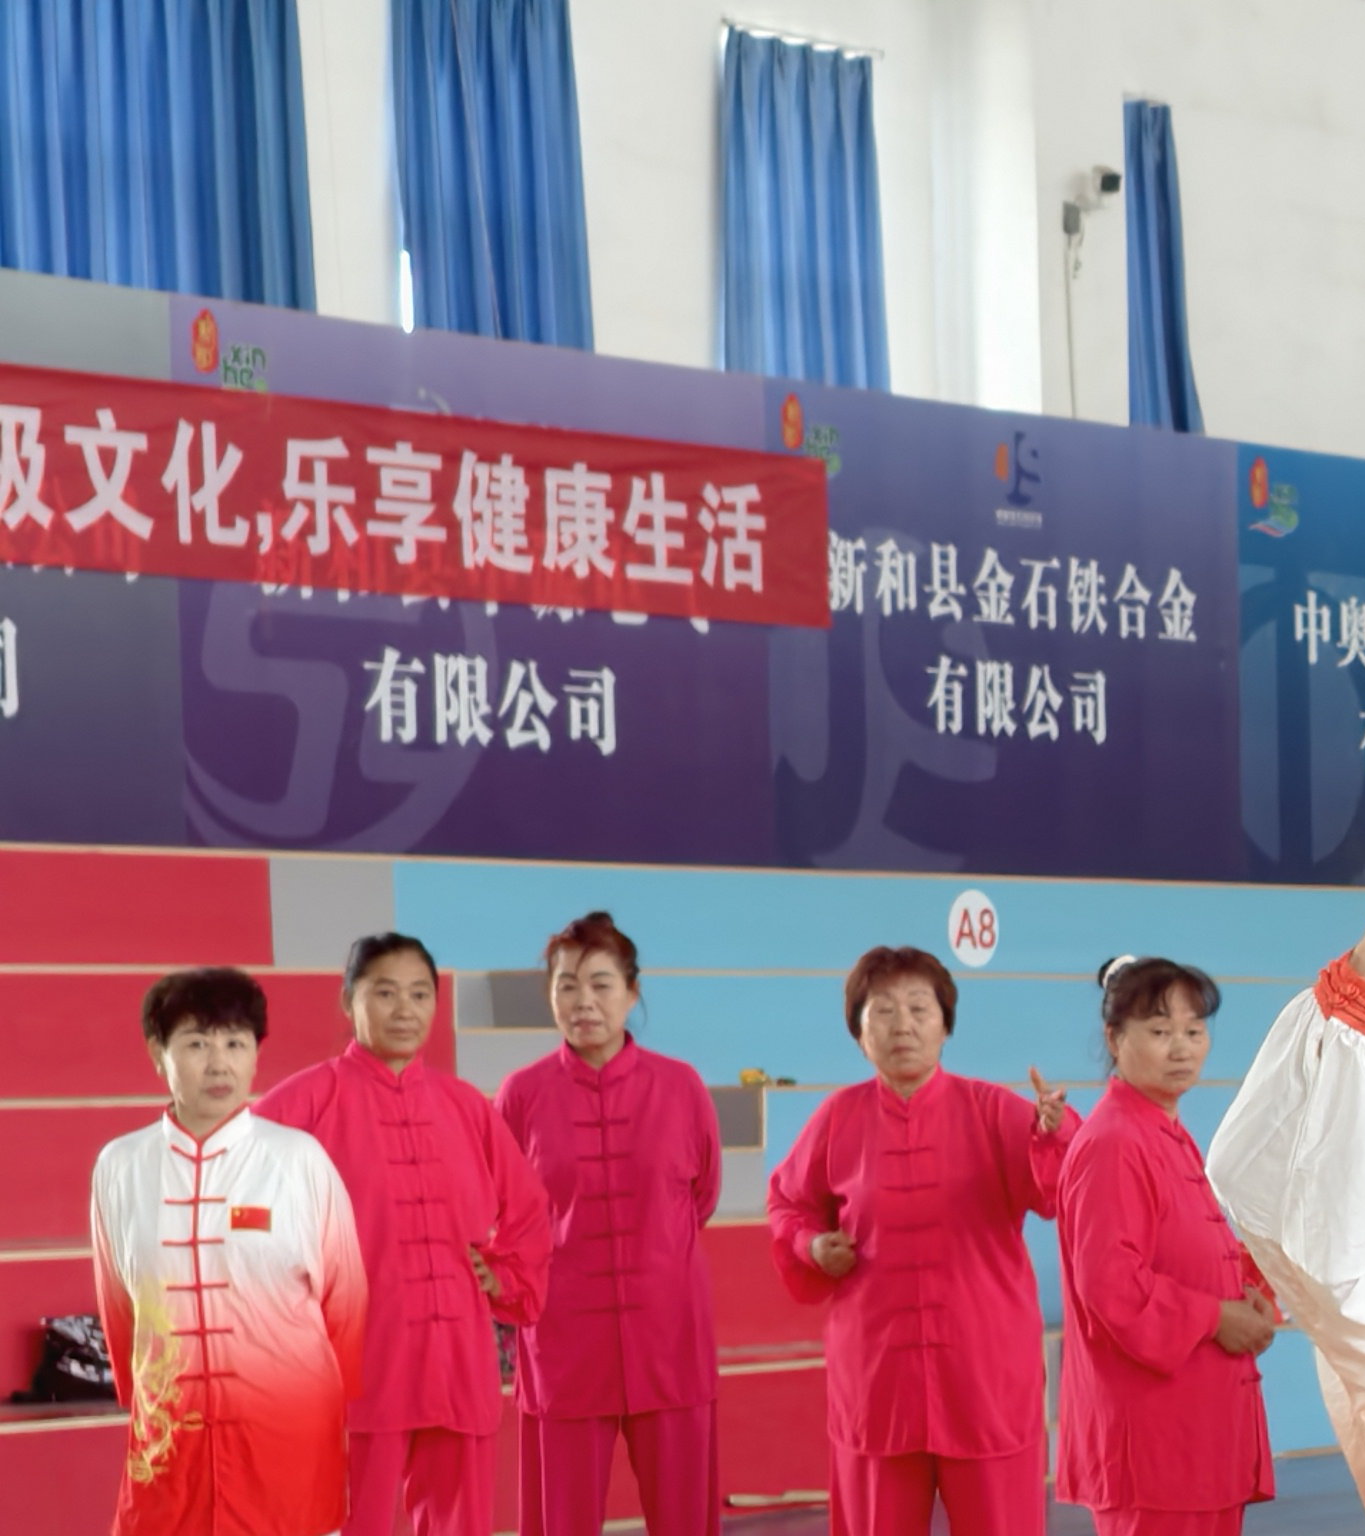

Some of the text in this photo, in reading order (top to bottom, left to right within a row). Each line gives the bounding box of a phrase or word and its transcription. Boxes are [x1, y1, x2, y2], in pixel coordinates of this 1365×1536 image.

[828, 528, 1198, 643] 新和县金石铁合金
[363, 646, 618, 756] 有限公司
[924, 654, 1107, 746] 有限公司
[953, 906, 996, 950] A8
